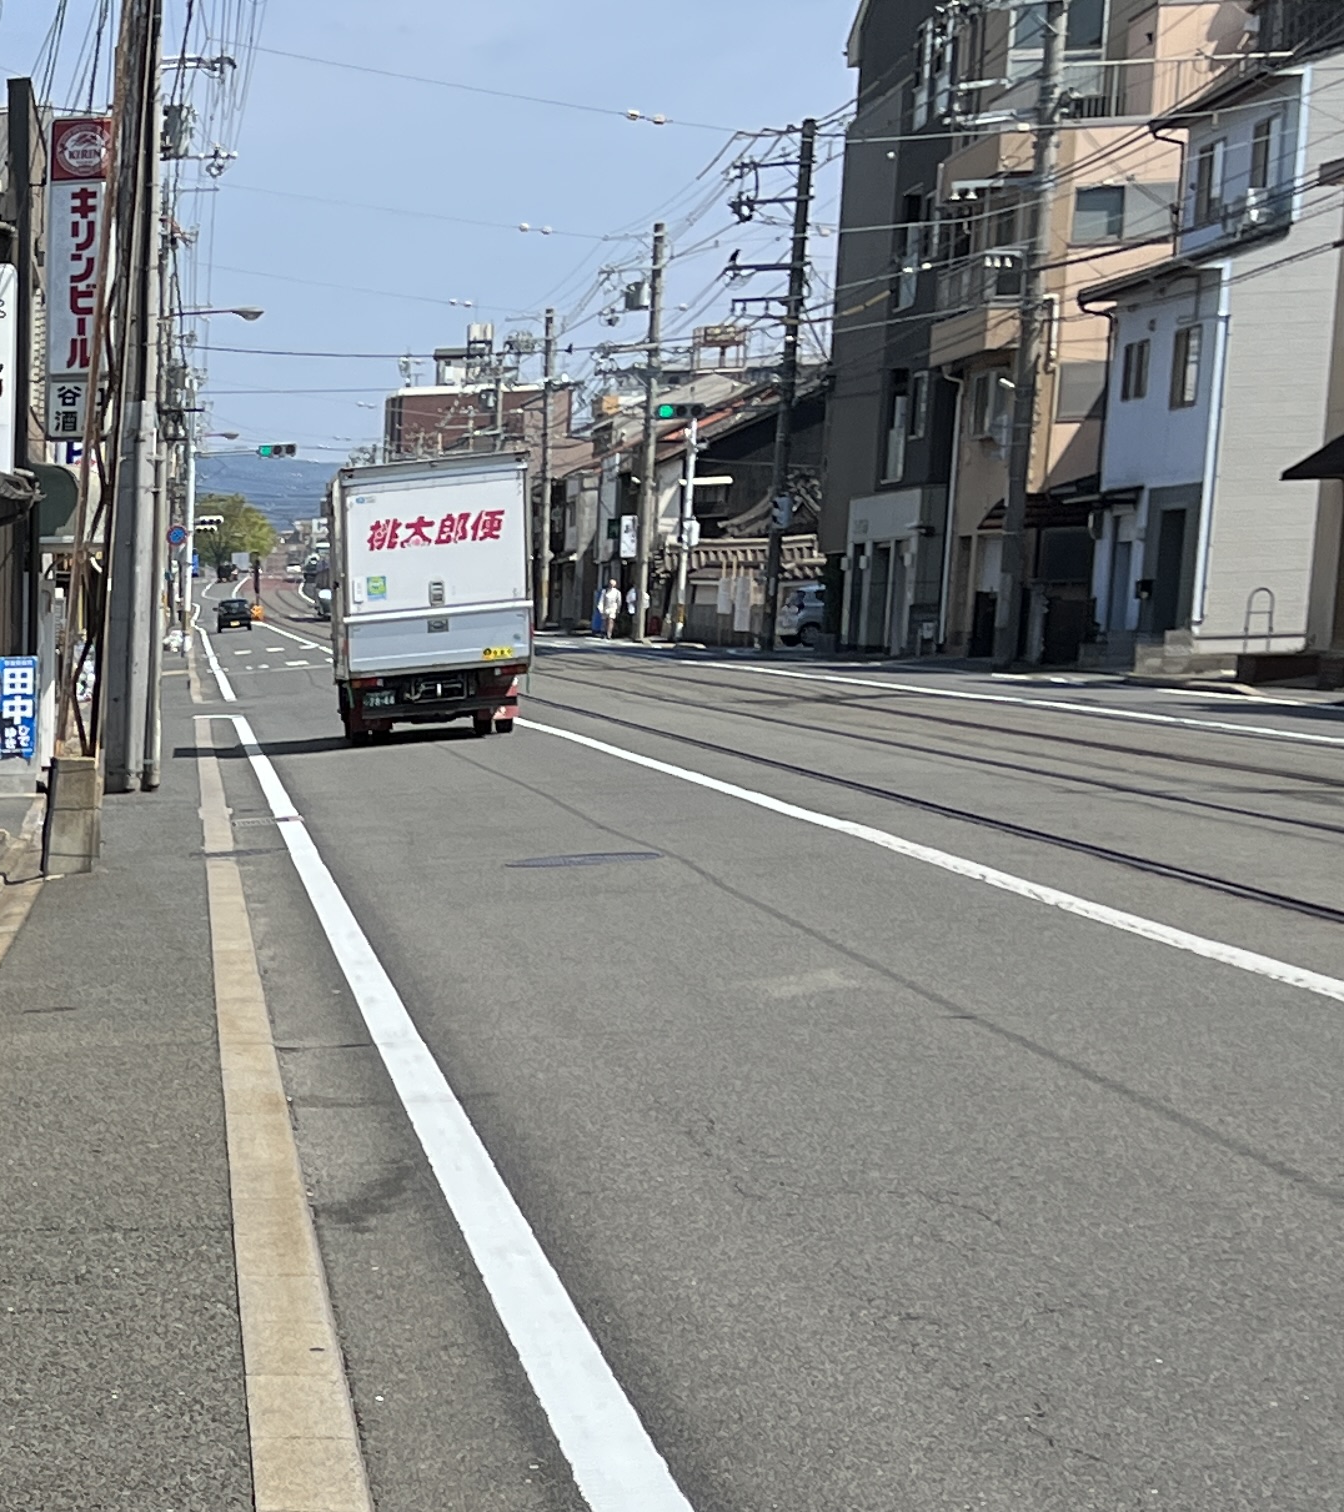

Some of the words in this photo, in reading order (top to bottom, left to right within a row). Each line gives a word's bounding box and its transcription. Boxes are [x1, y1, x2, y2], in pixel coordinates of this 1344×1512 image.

[68, 150, 101, 160] KIRIN
[67, 187, 97, 368] キリンビール
[366, 509, 505, 551] 桃太郎便
[2, 667, 34, 725] 田中
